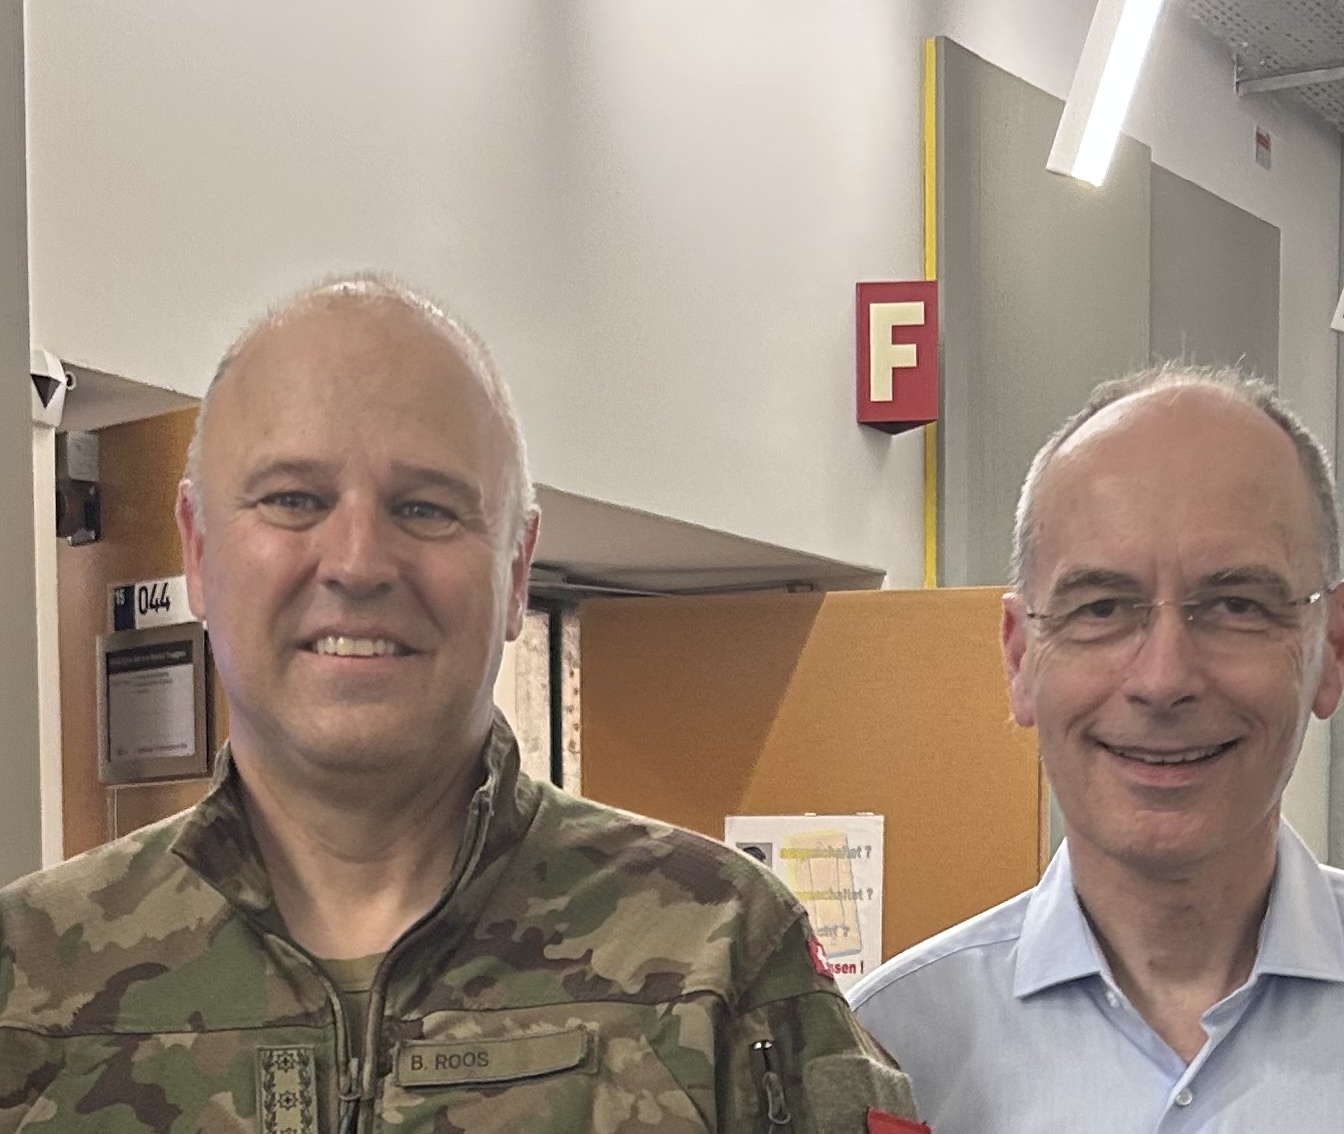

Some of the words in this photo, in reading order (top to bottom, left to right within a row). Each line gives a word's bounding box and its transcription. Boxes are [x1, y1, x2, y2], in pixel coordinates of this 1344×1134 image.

[869, 301, 925, 402] F
[139, 582, 171, 615] 044
[411, 1054, 427, 1071] B.
[435, 1052, 490, 1070] ROOS
